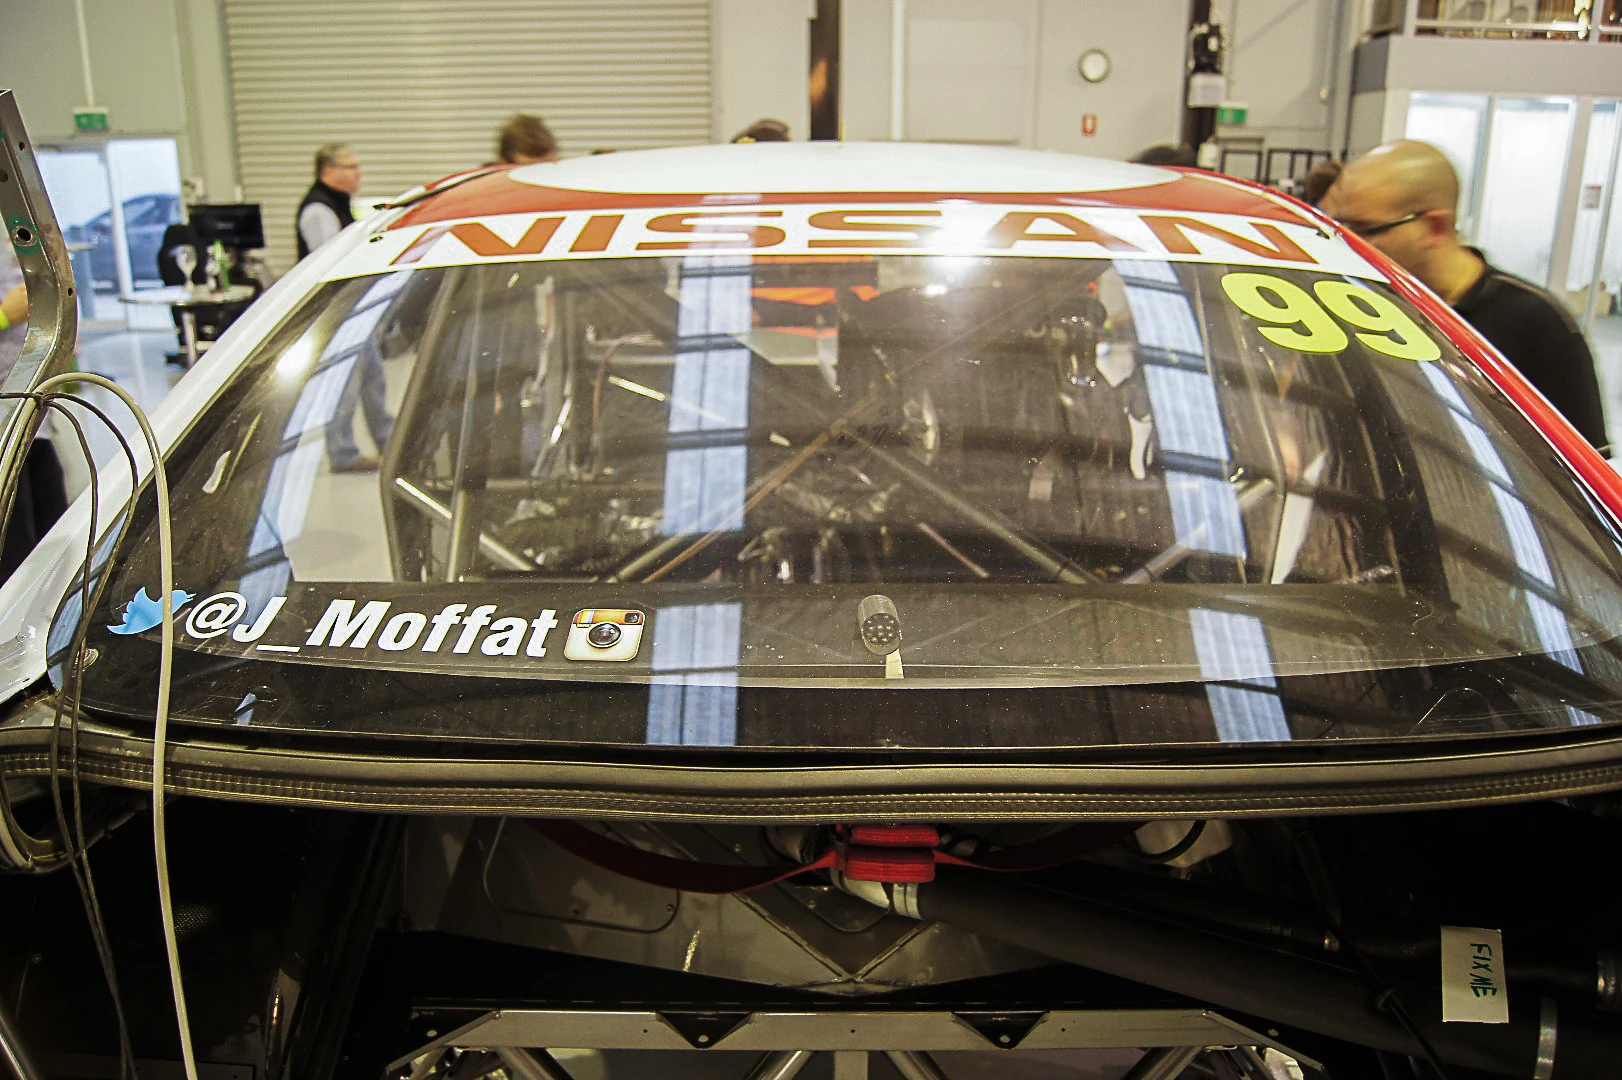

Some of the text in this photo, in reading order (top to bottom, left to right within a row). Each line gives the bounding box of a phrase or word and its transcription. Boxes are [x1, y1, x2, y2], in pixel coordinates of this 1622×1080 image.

[389, 209, 1319, 266] NISSAN
[1221, 272, 1441, 362] 99
[185, 592, 558, 658] @J_Moffat
